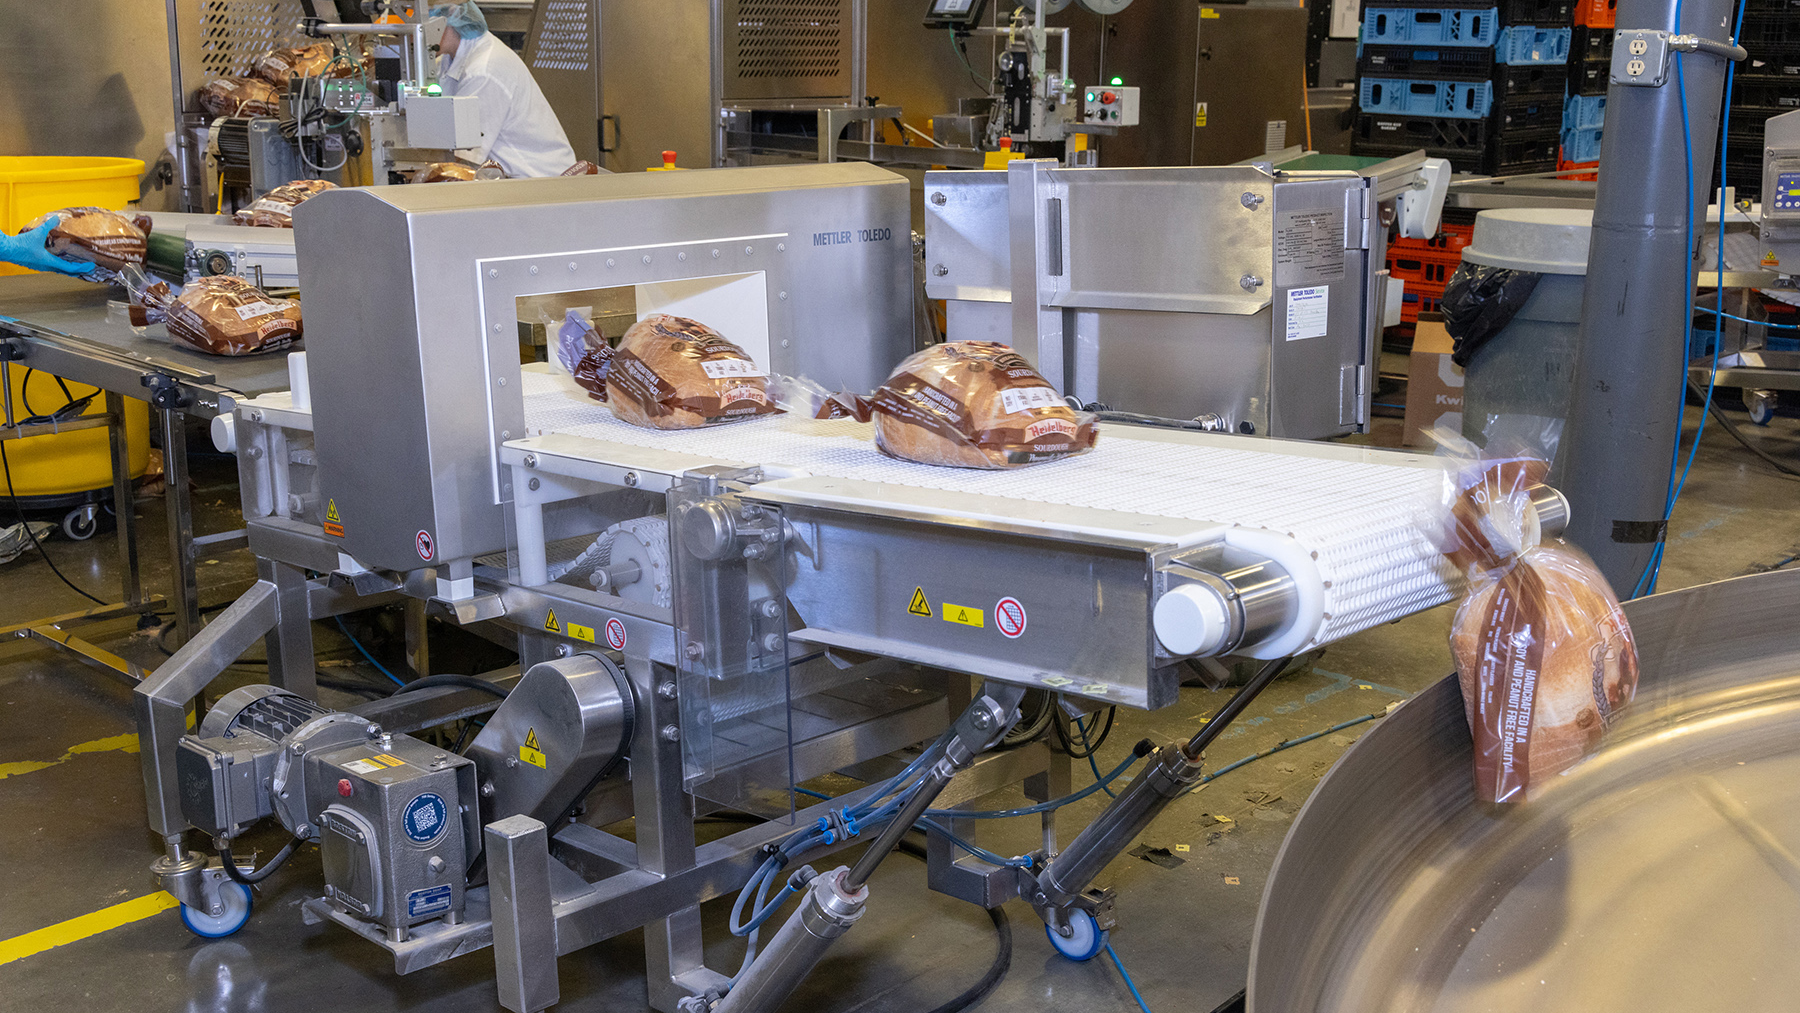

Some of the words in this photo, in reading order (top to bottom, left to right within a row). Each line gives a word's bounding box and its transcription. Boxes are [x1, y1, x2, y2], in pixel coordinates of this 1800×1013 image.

[813, 231, 852, 246] METTLER
[857, 228, 891, 242] TOLEDO
[260, 321, 294, 334] Heidelberg
[1436, 394, 1464, 405] Kwi
[1029, 421, 1076, 437] Heidelberg
[1034, 443, 1068, 452] SOURDOUGH
[1516, 645, 1528, 660] SOY
[1513, 660, 1525, 677] AND
[1508, 680, 1522, 709] PEANUT
[1518, 669, 1536, 726] HANDCRAFTED
[1505, 710, 1518, 730] FREE
[1503, 731, 1514, 768] FACILITY
